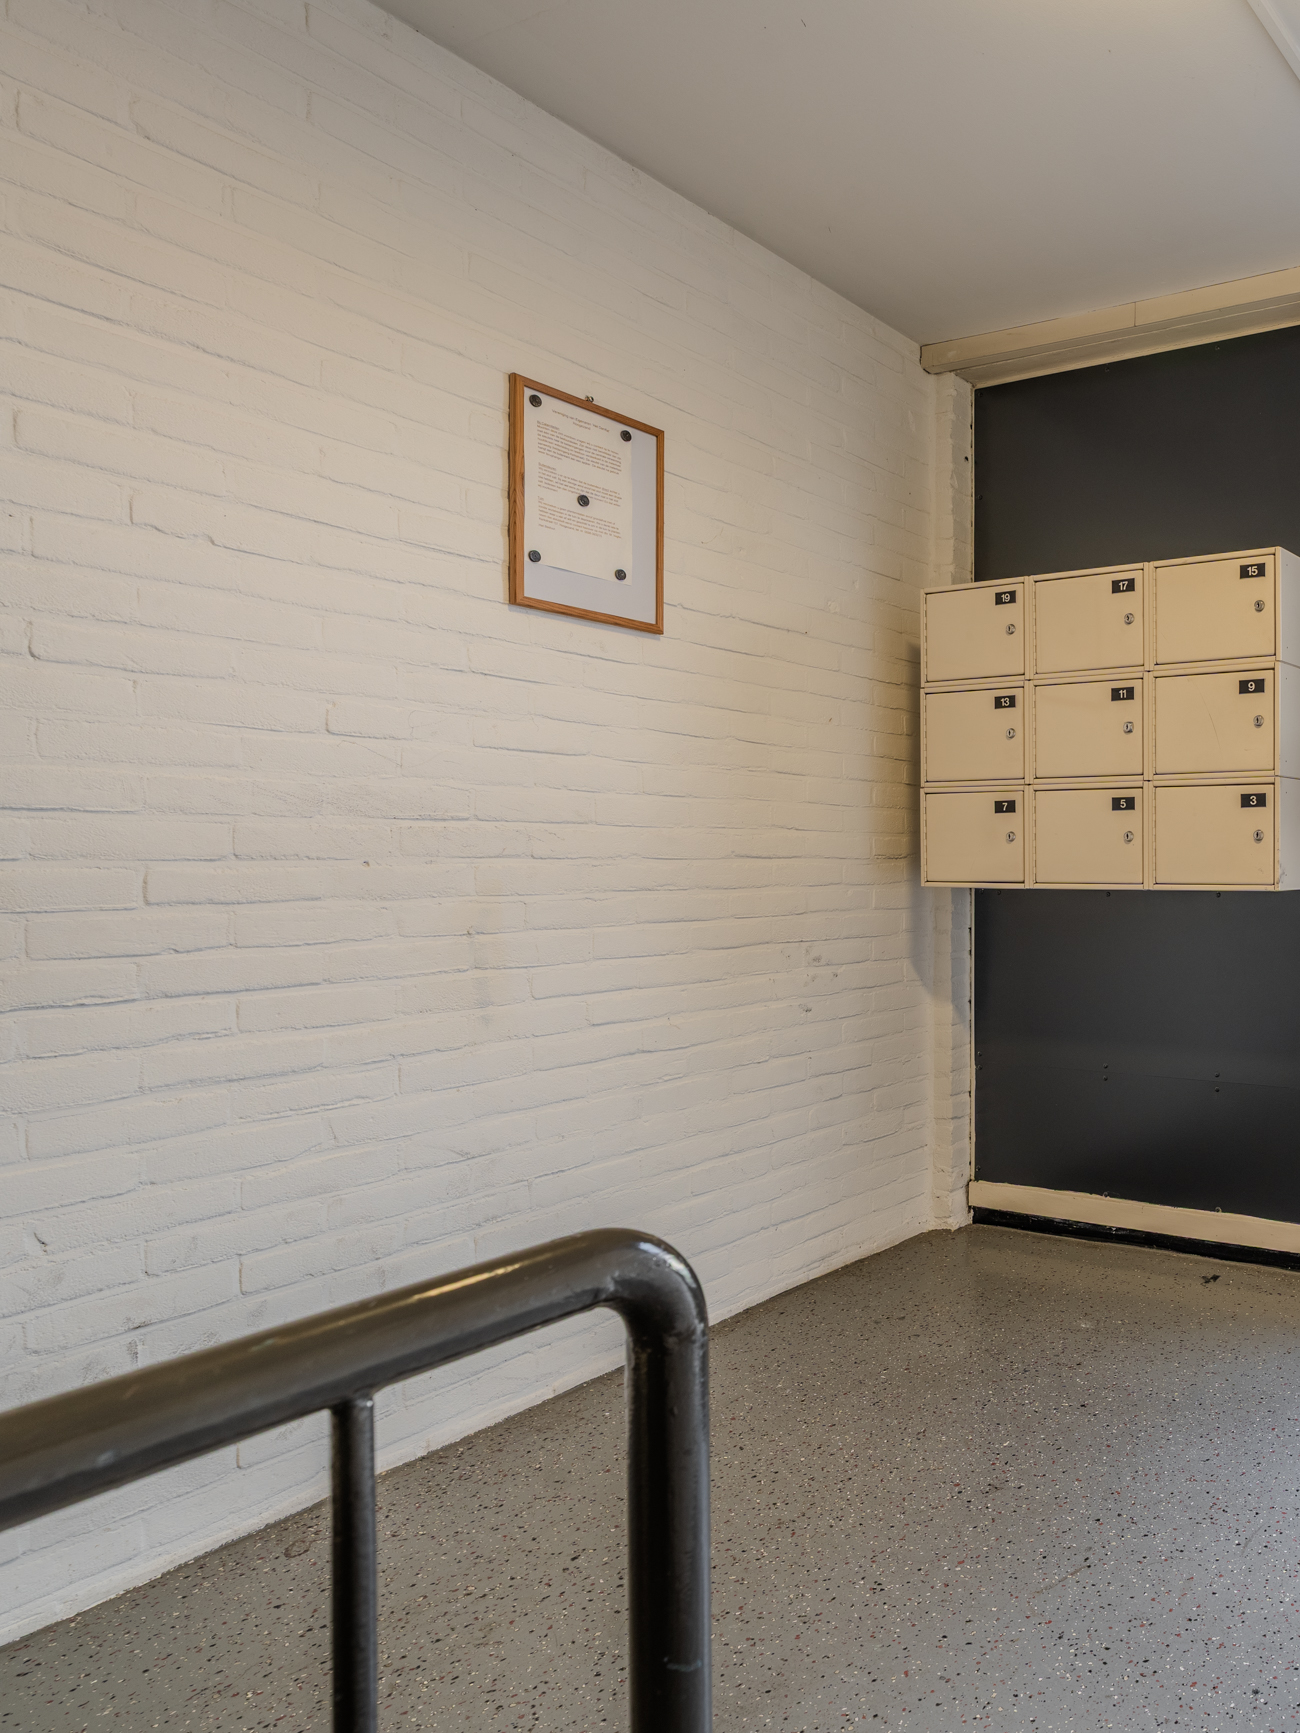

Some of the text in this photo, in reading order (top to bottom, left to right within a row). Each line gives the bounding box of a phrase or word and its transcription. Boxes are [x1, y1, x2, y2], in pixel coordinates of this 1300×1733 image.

[1247, 566, 1258, 576] 15
[1118, 581, 1128, 590] 17
[1001, 593, 1011, 602] 19
[1247, 681, 1255, 691] 9
[1119, 689, 1127, 698] 11
[1000, 697, 1010, 706] 13
[1120, 799, 1127, 808] 5
[1249, 796, 1257, 805] 3
[1002, 802, 1008, 811] 7
